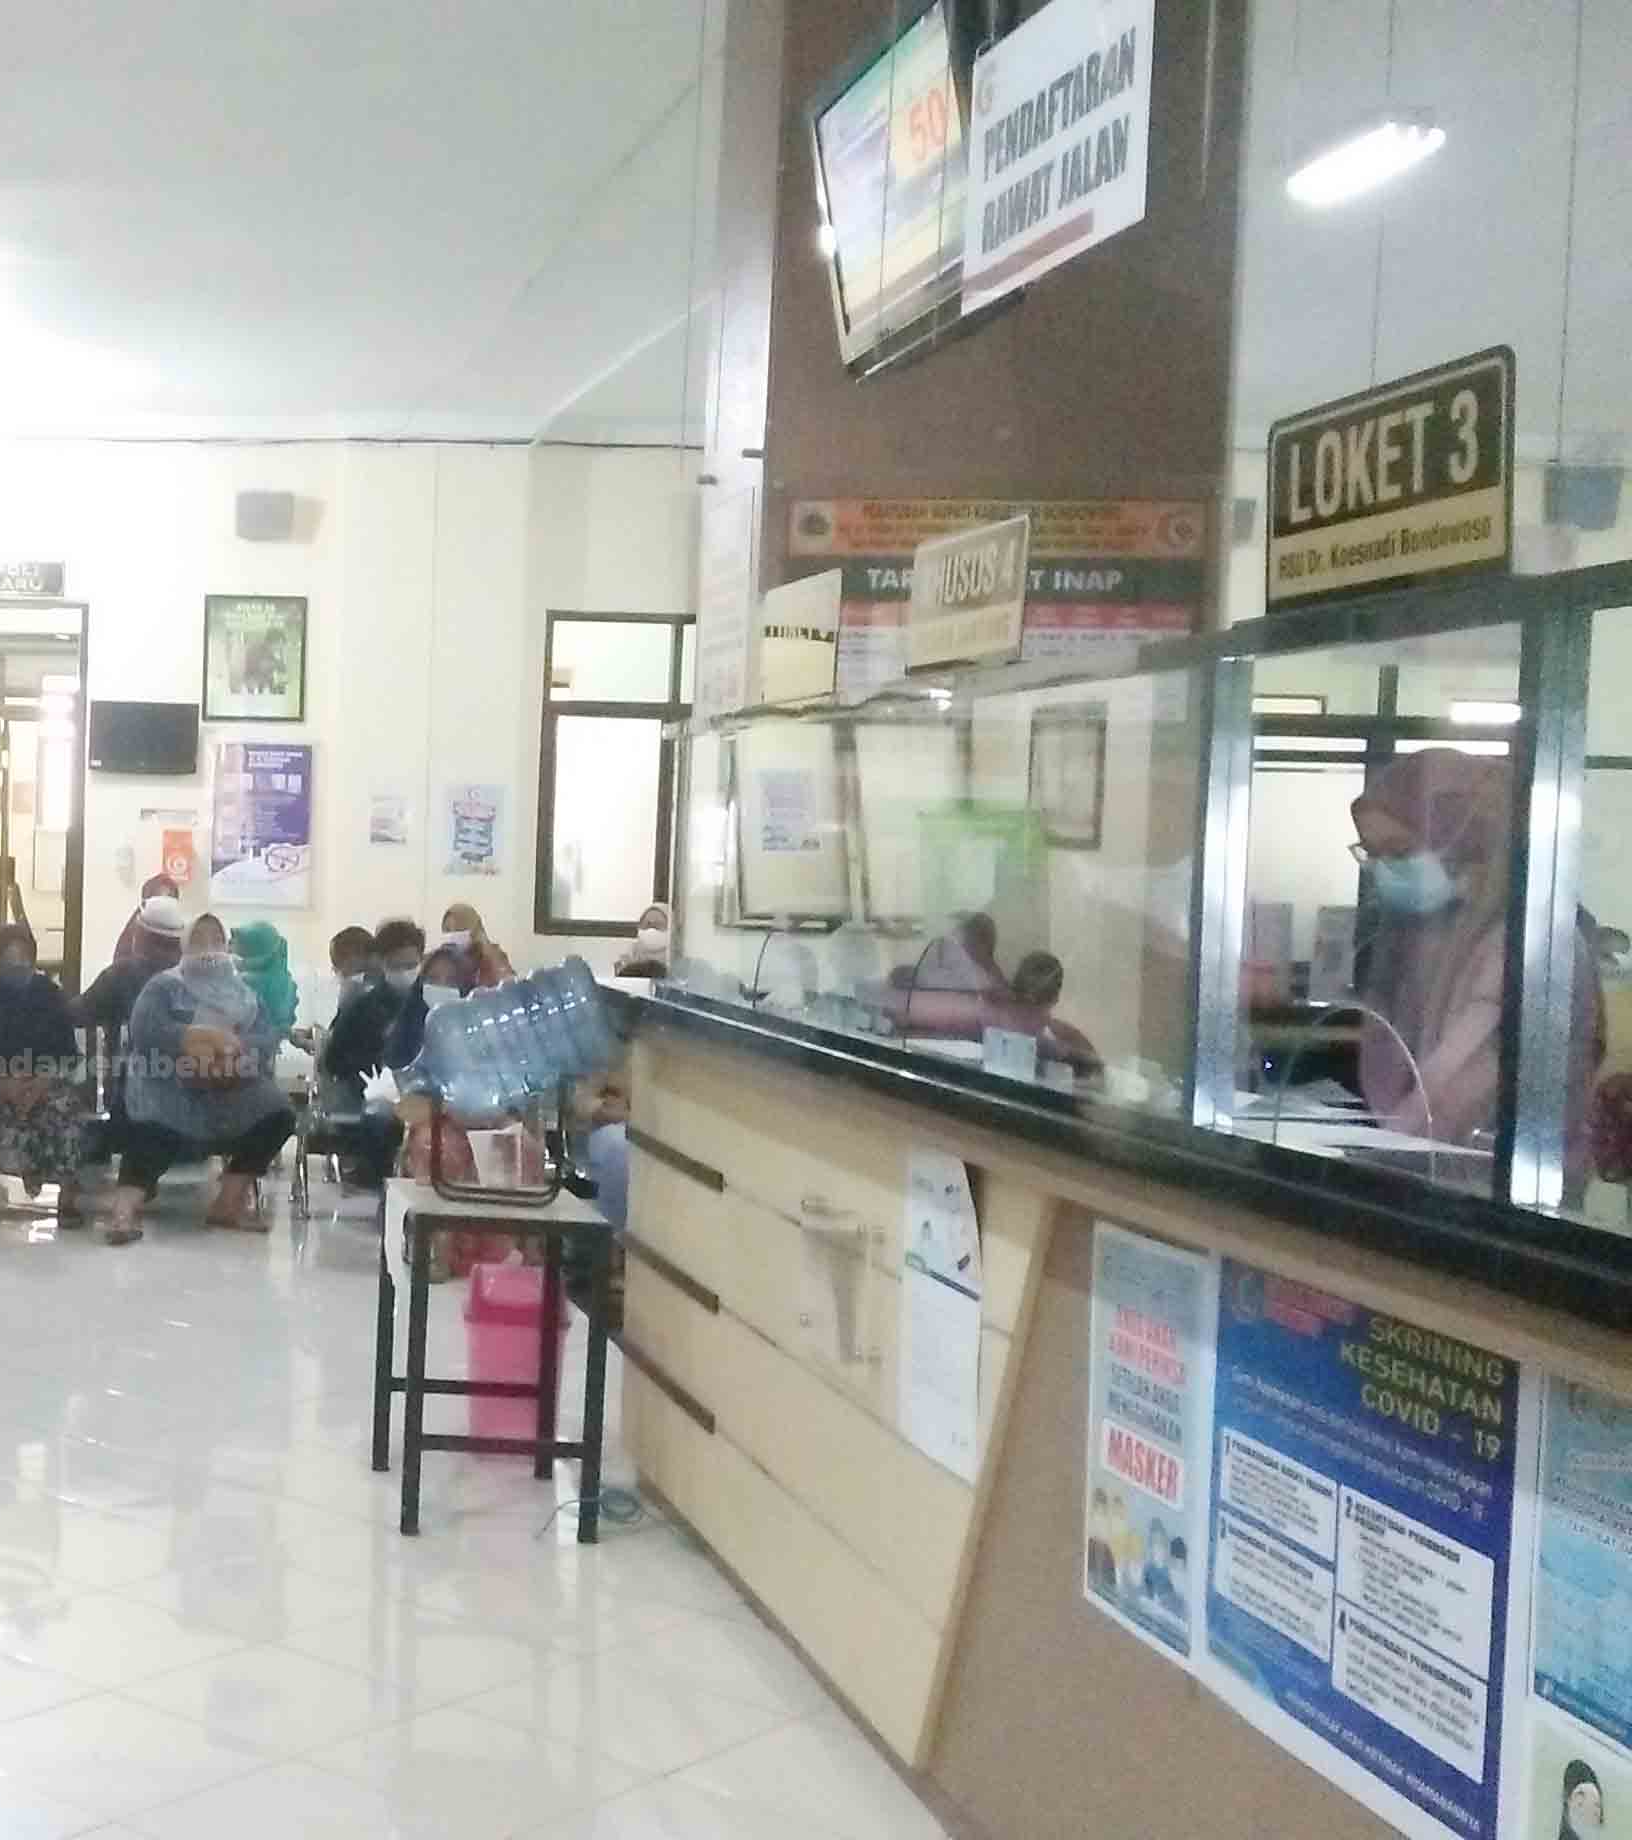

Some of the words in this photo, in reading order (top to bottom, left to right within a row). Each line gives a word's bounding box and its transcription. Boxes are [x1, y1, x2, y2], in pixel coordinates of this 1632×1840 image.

[983, 26, 1136, 182] PENDAFTARAN
[981, 160, 1055, 254] RAWAT
[1057, 112, 1131, 211] JALAN
[1287, 401, 1435, 524] LOKET
[1448, 389, 1479, 484] 3
[1054, 567, 1124, 592] INAP
[1307, 548, 1328, 576] Dr.
[1339, 1341, 1504, 1426] KESEHATAN
[1369, 1315, 1505, 1386] SKRINING
[1359, 1382, 1441, 1436] COVID
[1473, 1429, 1502, 1461] 19
[1106, 1426, 1180, 1502] MASKER
